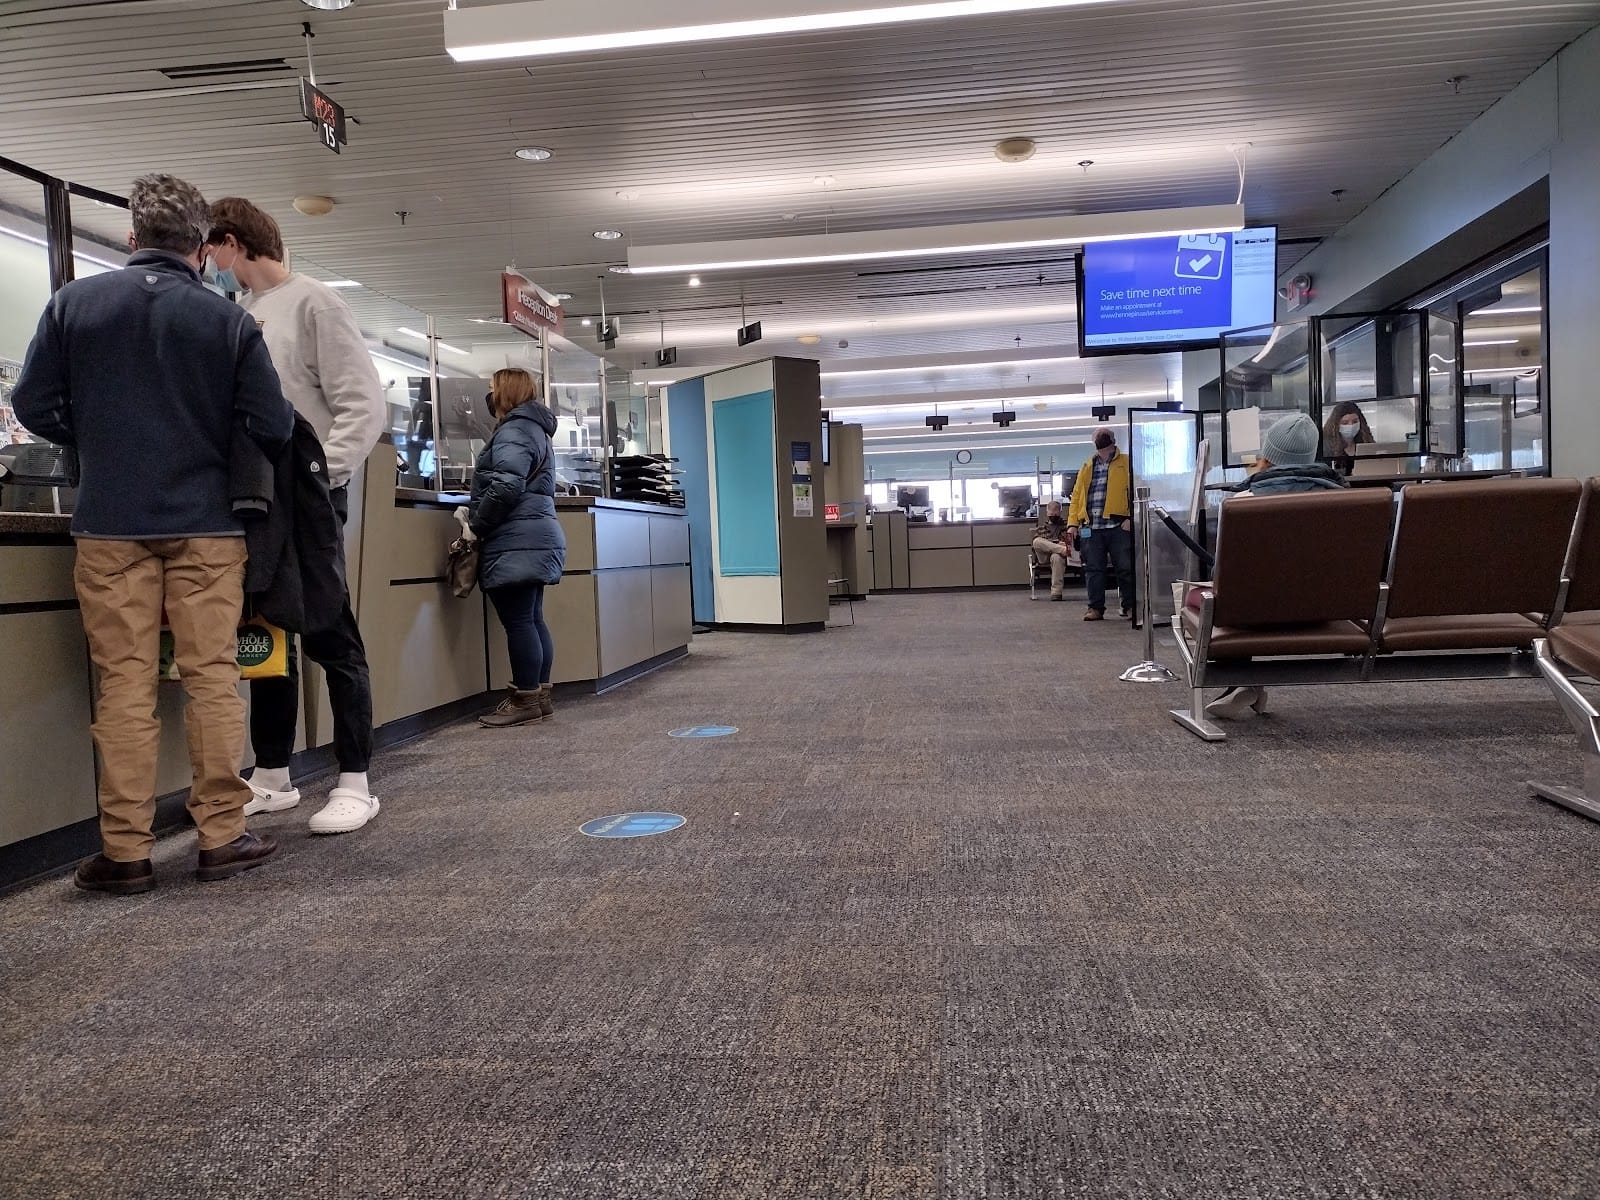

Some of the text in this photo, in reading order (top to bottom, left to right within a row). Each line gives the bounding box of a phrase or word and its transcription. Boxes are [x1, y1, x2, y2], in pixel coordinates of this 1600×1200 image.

[323, 123, 335, 147] 15
[1100, 285, 1202, 301] Save time next time
[518, 288, 558, 323] Reception Desk
[1100, 304, 1114, 312] Make
[1122, 302, 1156, 311] appointment
